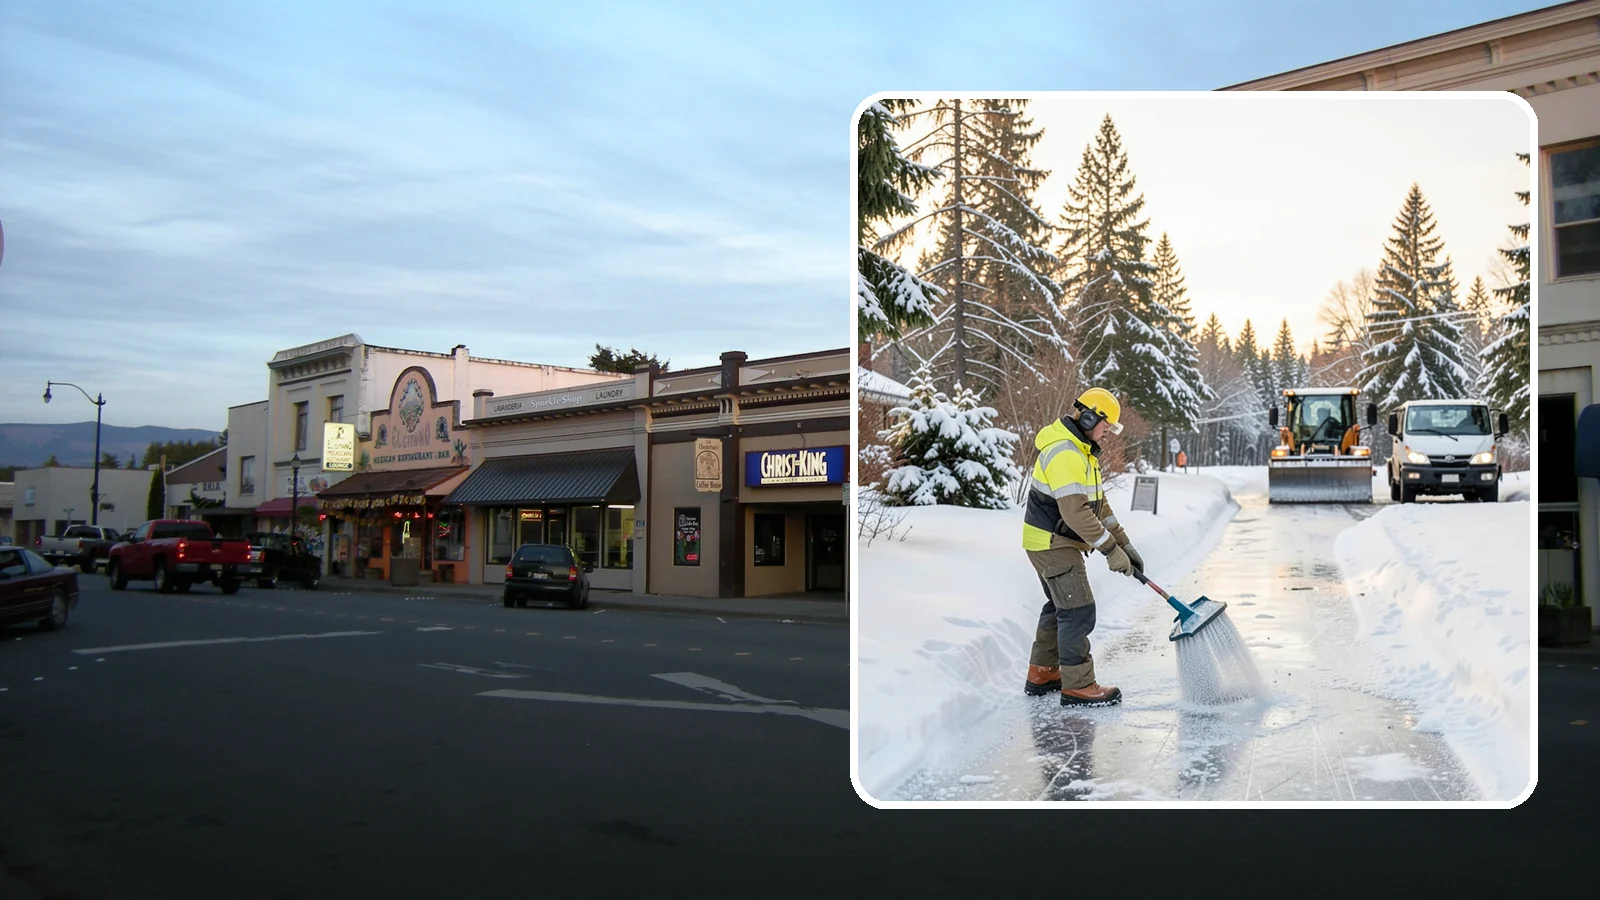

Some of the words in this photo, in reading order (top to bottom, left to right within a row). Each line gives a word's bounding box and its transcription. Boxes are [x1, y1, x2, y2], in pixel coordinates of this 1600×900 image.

[561, 395, 582, 404] Shop
[596, 389, 623, 400] LAUNDRY
[494, 402, 522, 412] LAVANDERIA
[374, 455, 396, 464] MEXICAN
[397, 451, 433, 462] RESTAURANT
[438, 450, 450, 459] BAR
[760, 452, 798, 478] CHRIST
[799, 450, 828, 476] KING
